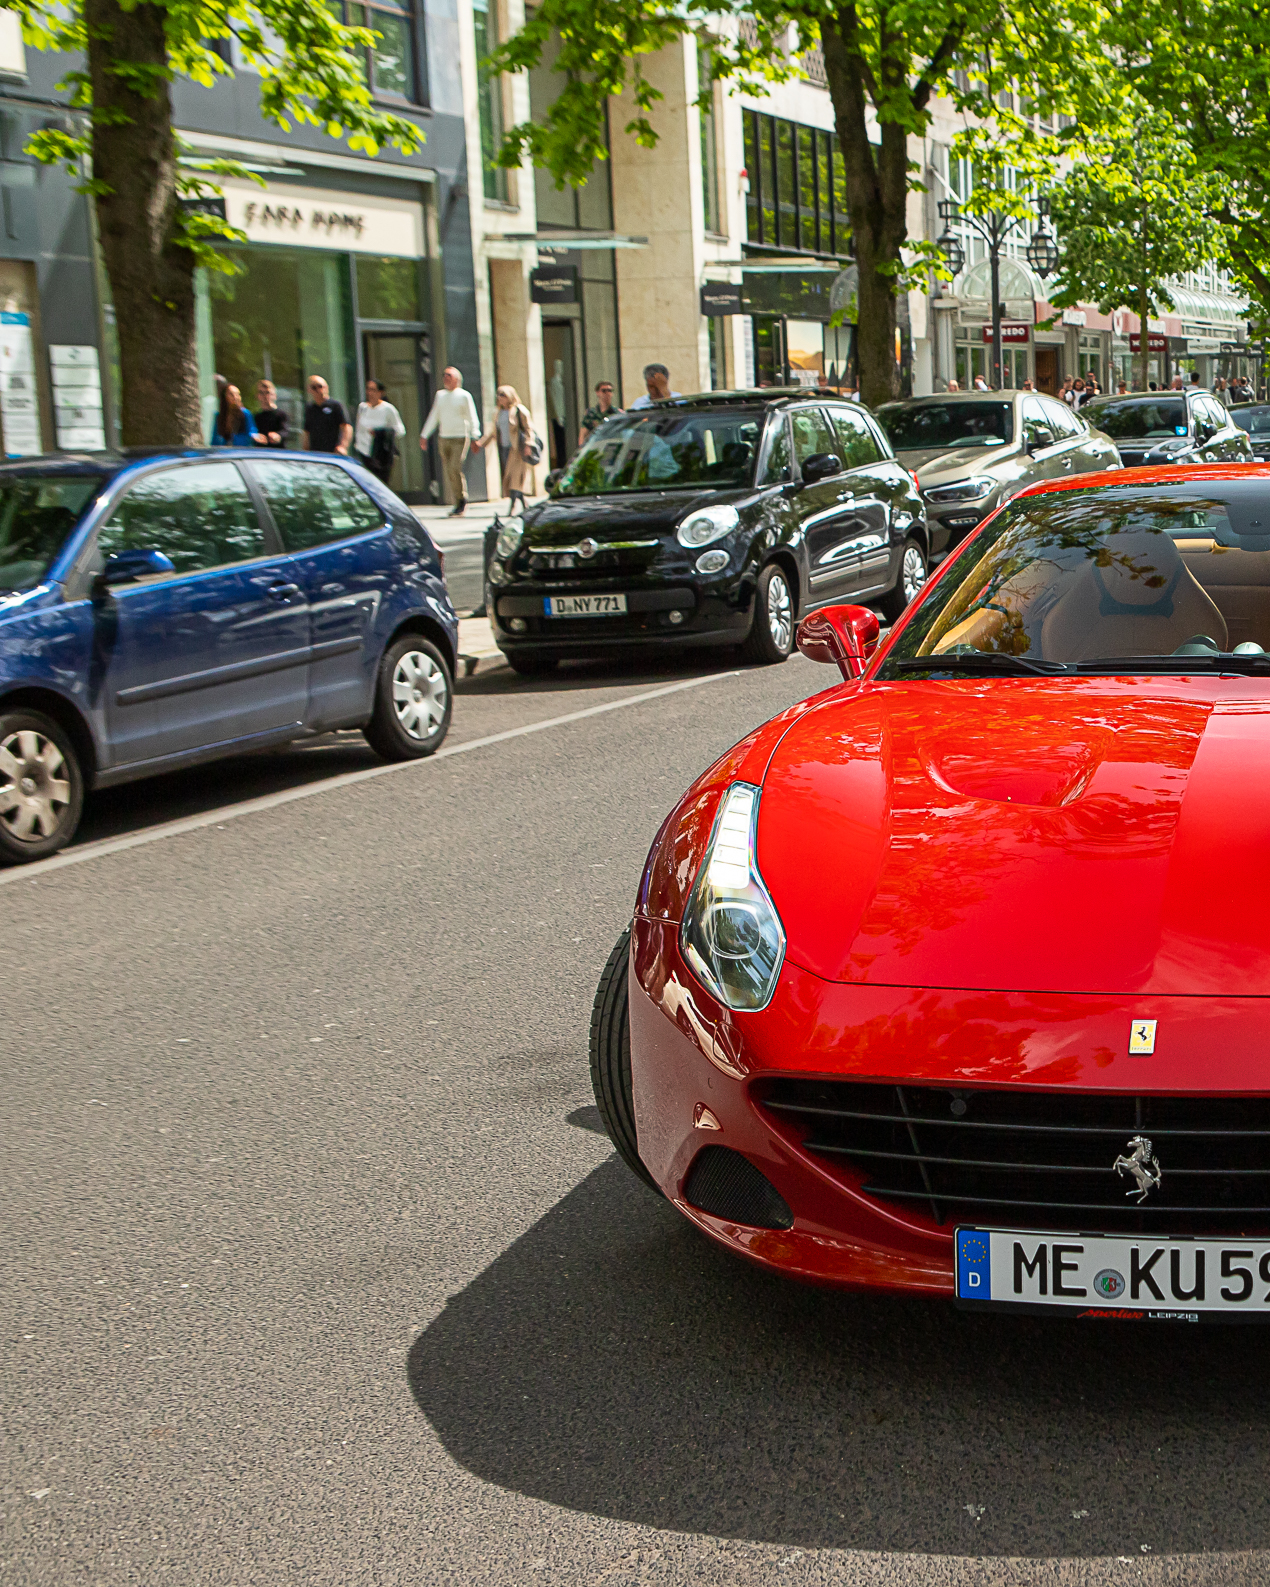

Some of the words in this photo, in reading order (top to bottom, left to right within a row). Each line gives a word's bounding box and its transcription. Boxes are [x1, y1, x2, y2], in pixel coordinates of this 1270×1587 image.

[985, 327, 1026, 336] MREDO
[1131, 338, 1165, 347] MEDO
[557, 598, 565, 613] D
[573, 597, 590, 612] NY
[594, 596, 620, 611] 771
[1013, 1241, 1087, 1297] ME
[1131, 1245, 1205, 1301] KU
[969, 1272, 980, 1286] D
